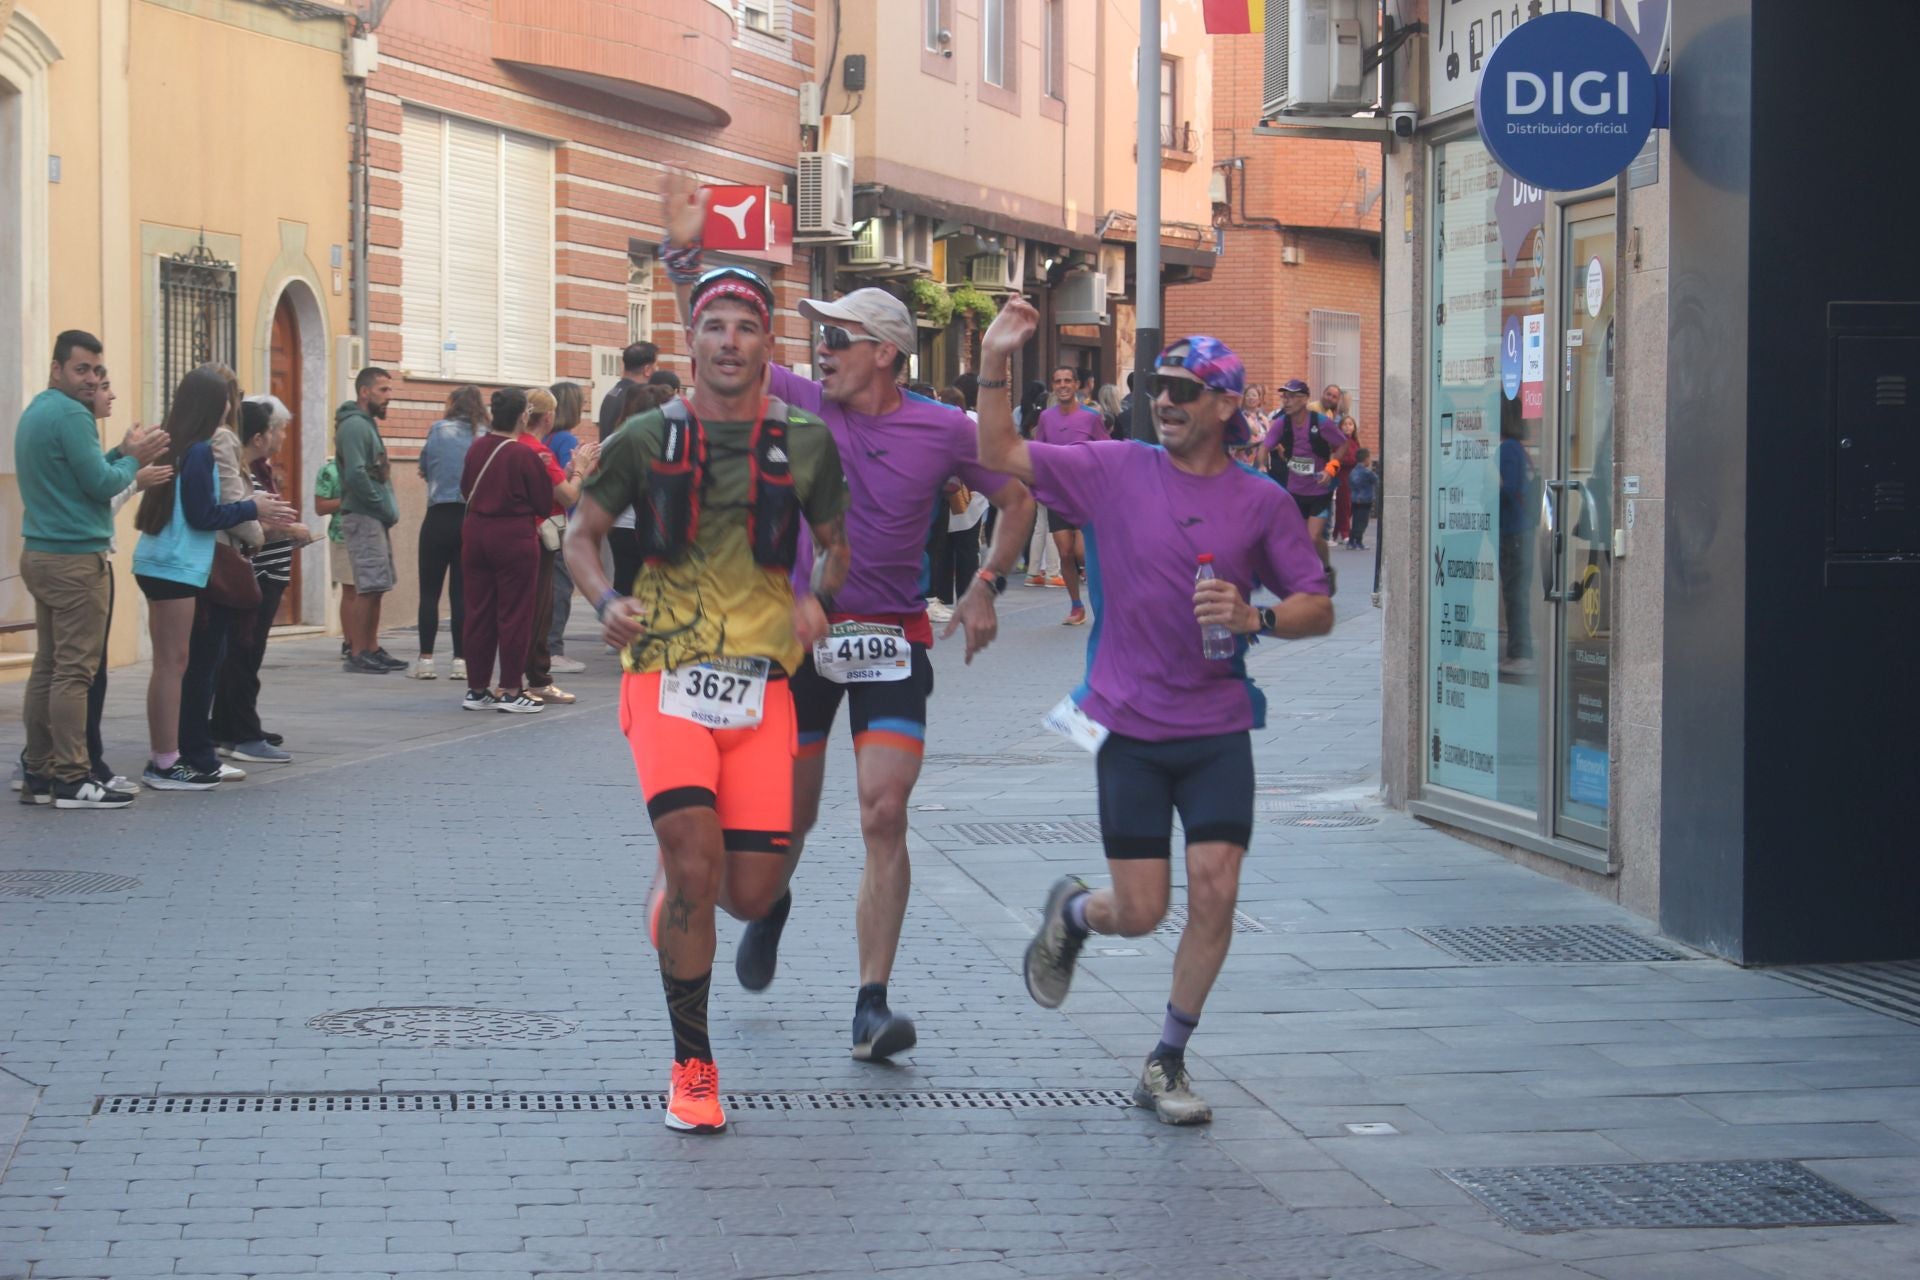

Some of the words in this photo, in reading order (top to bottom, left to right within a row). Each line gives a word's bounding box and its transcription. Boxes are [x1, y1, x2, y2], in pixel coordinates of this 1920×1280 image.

[1506, 71, 1629, 116] DIGI
[1506, 123, 1584, 135] Distribuidor
[1585, 123, 1628, 135] oficial
[1513, 179, 1542, 207] DI
[1584, 587, 1601, 626] ups
[837, 637, 898, 661] 4198
[685, 670, 752, 705] 3627
